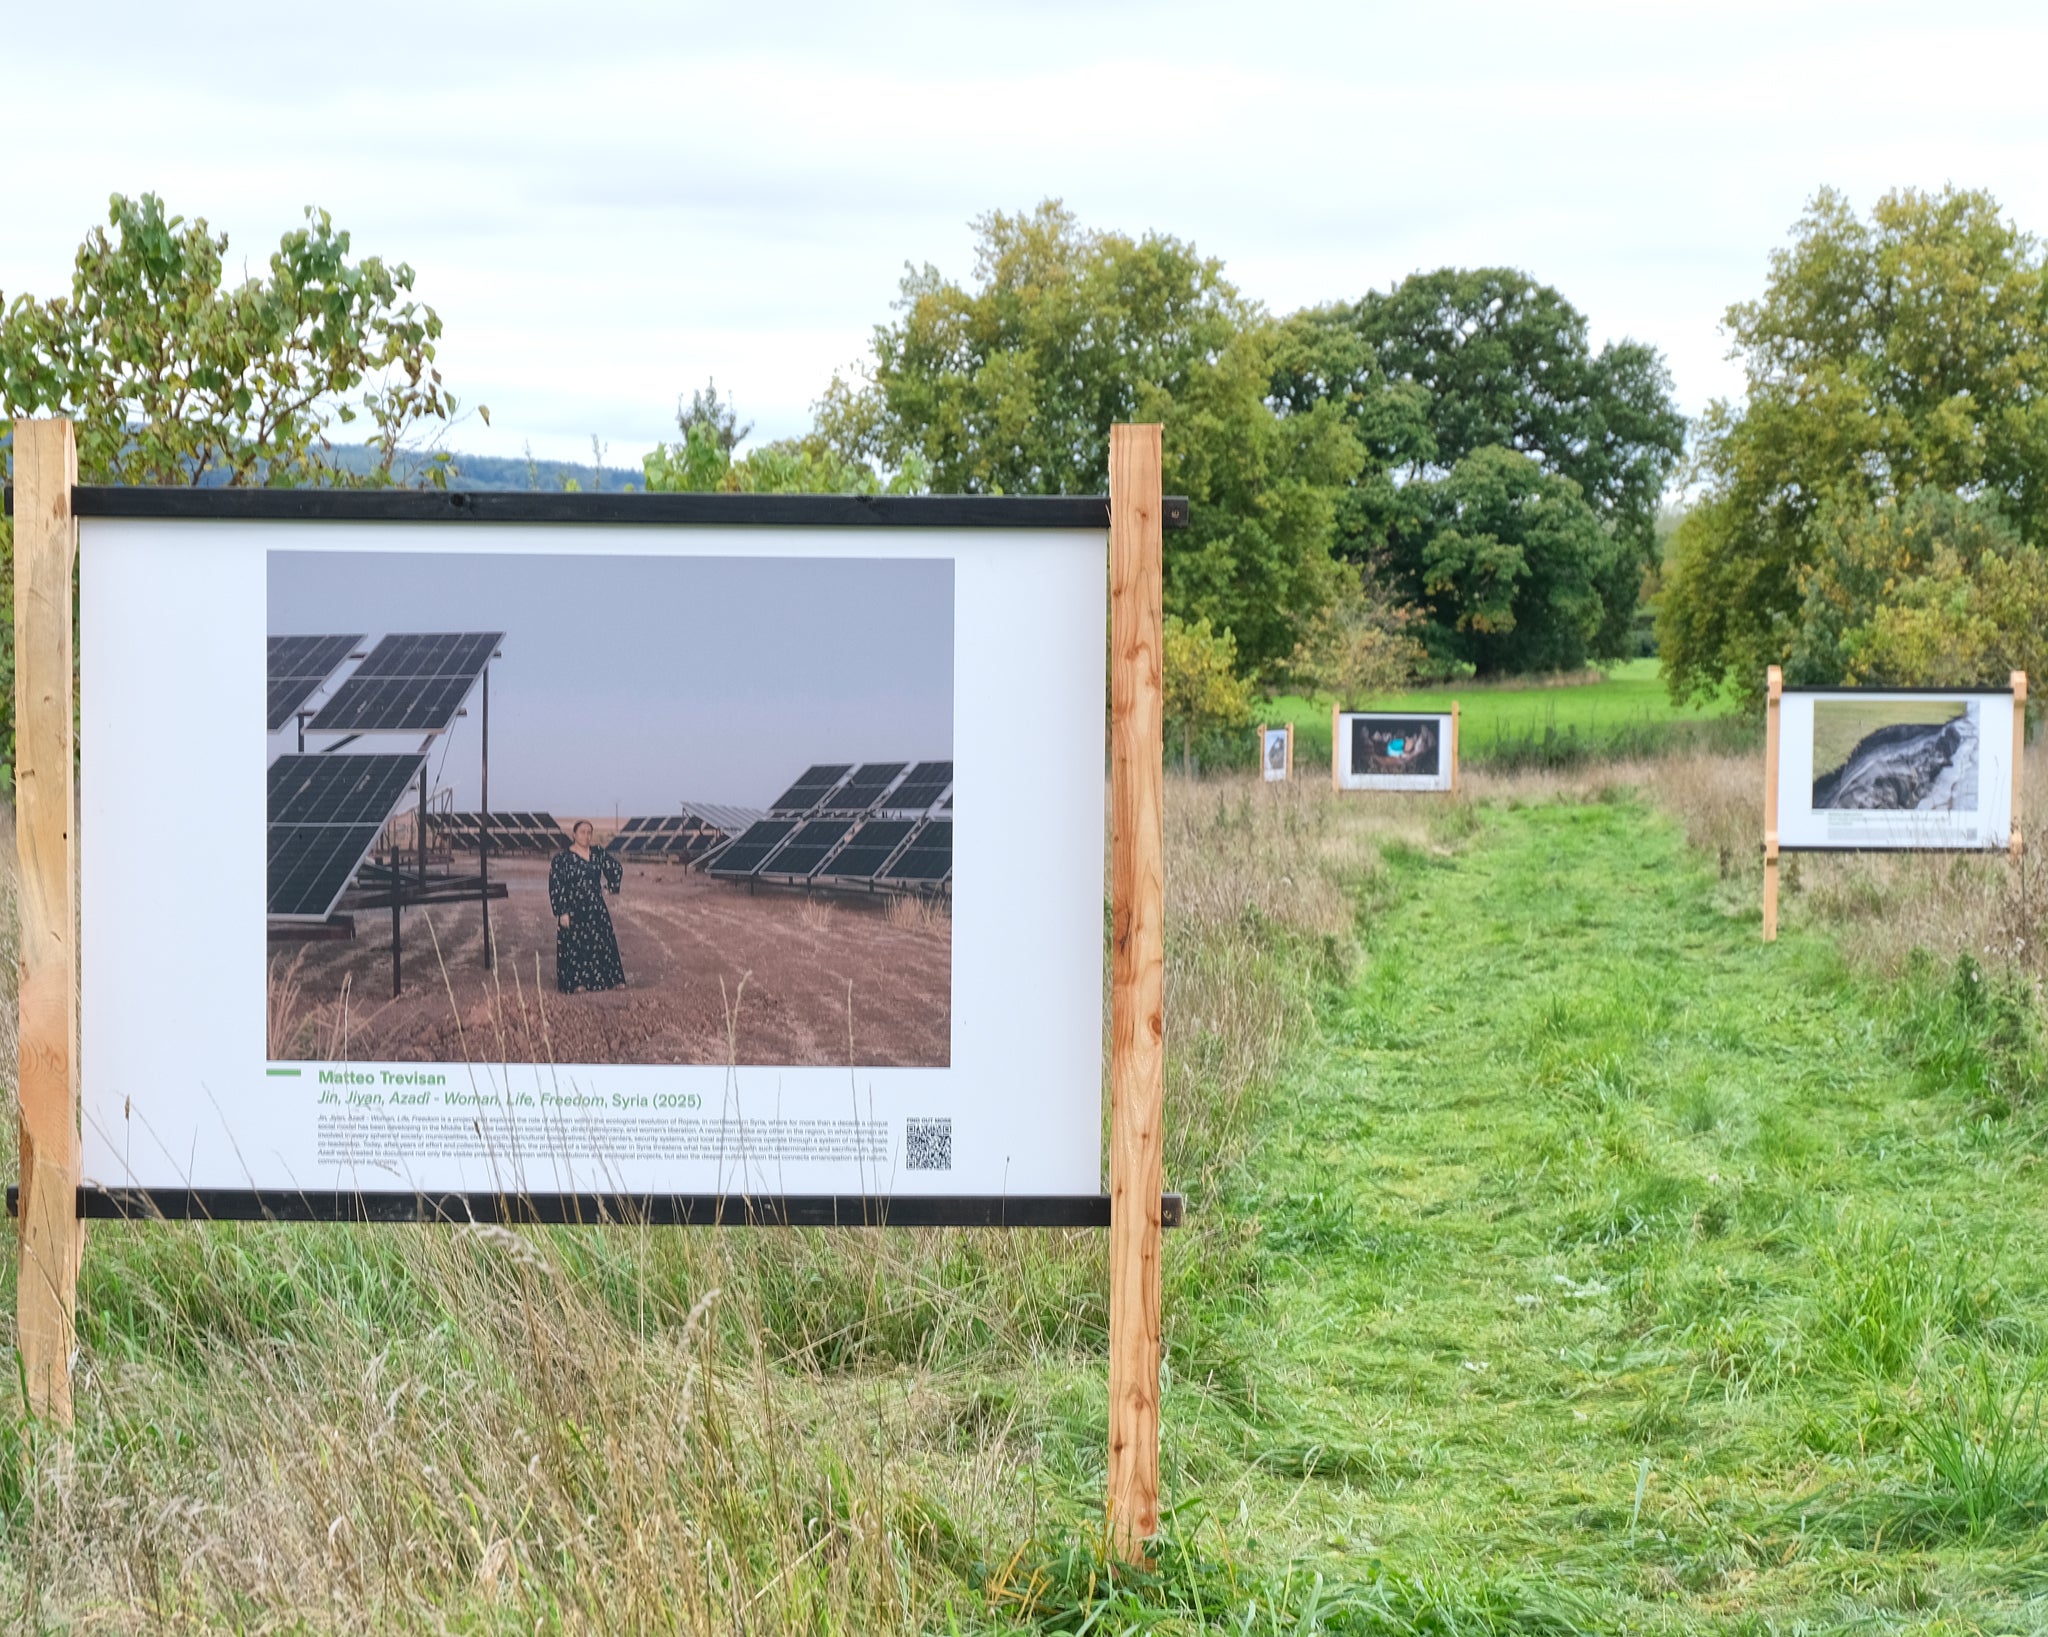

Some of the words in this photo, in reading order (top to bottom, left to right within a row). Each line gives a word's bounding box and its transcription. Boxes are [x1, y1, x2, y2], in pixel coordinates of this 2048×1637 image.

[319, 1070, 375, 1085] Matteo
[380, 1070, 447, 1086] Trevisan
[317, 1090, 341, 1106] Jin,
[345, 1091, 385, 1107] Jiyan,
[445, 1092, 501, 1107] Woman,
[541, 1093, 608, 1109] Freedom,
[612, 1093, 648, 1110] Syria
[653, 1093, 702, 1110] (2025)
